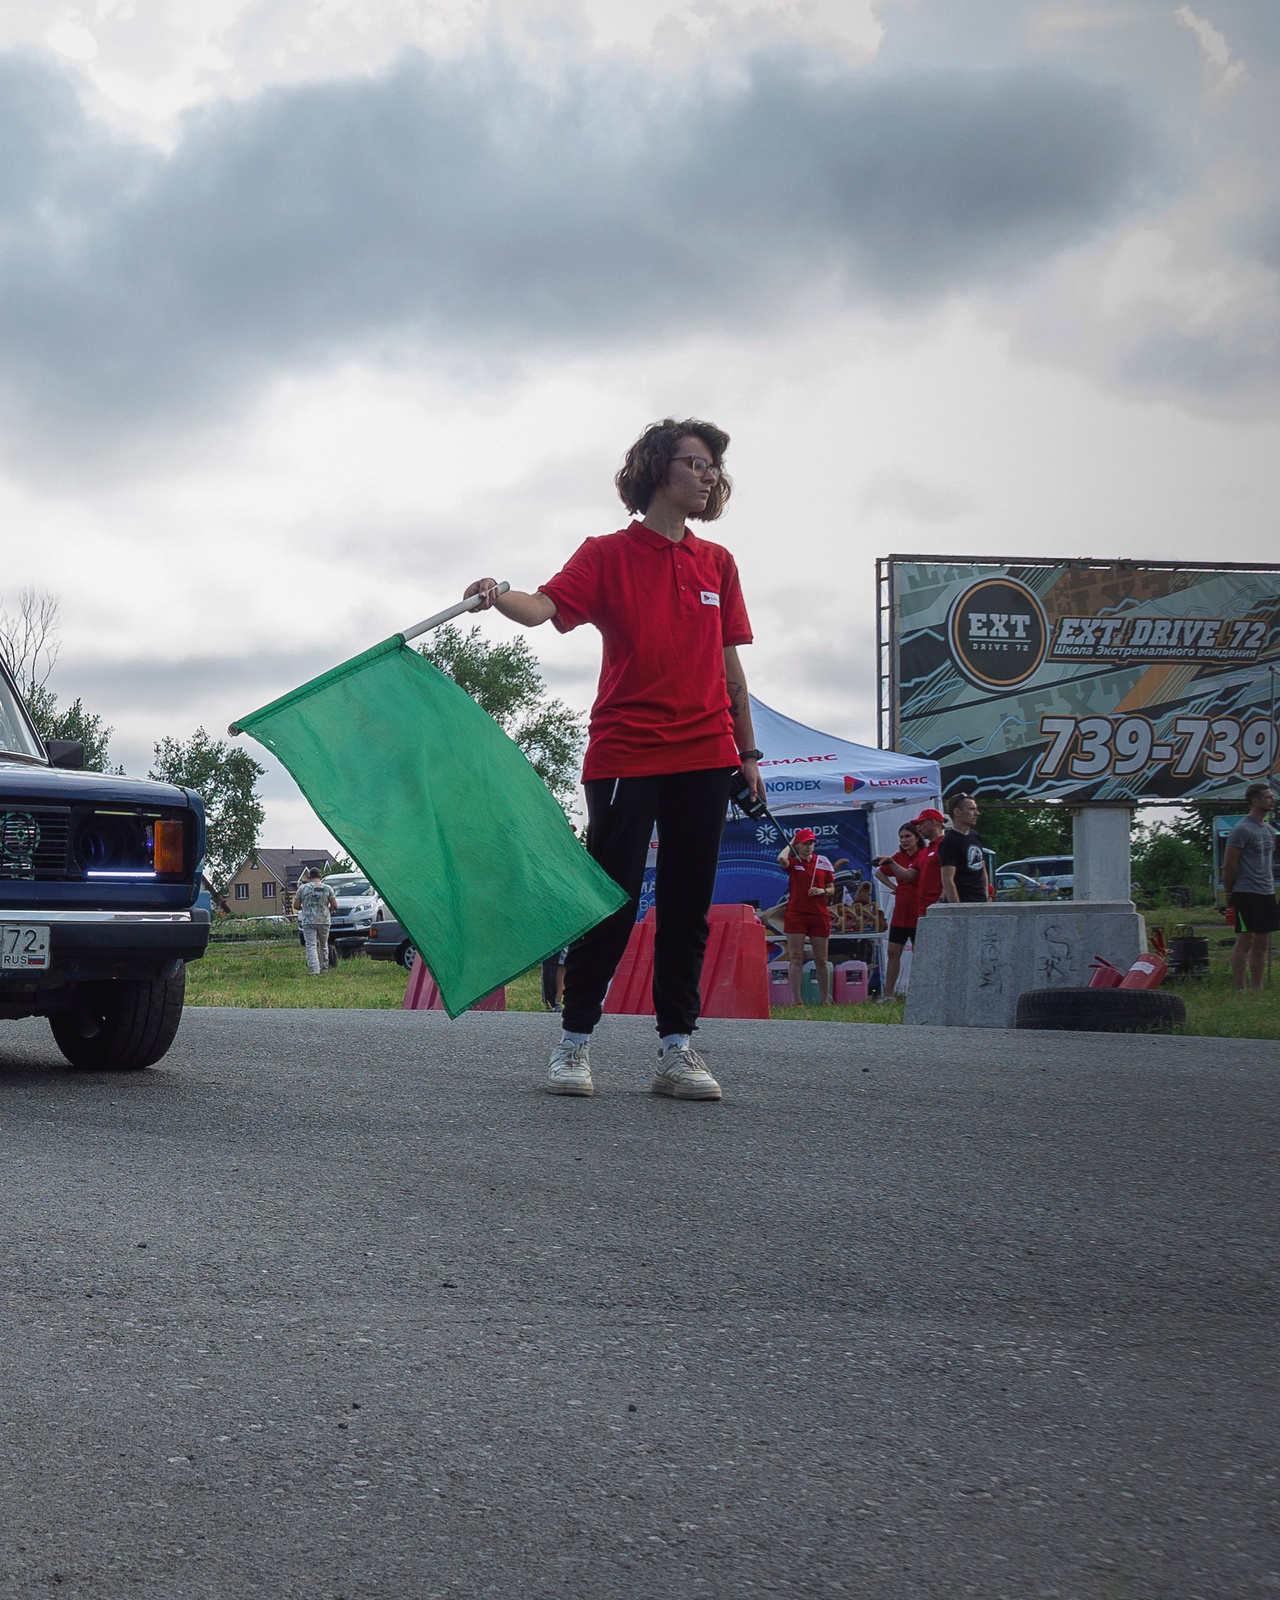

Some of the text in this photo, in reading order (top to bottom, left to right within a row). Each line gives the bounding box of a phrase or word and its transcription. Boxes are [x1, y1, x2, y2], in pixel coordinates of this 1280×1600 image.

[968, 613, 1031, 638] EXT
[1057, 618, 1268, 649] EXT DRIVE 72
[972, 643, 1029, 652] DRIVE 72
[1053, 645, 1258, 659] Школа Экстремального вождения
[1038, 716, 1278, 776] 739-739
[758, 754, 839, 767] EMARC
[766, 780, 821, 793] NORDEX
[870, 776, 928, 787] LEMARC
[783, 824, 839, 838] NODEX
[7, 929, 37, 953] 72
[4, 956, 27, 965] RUS
